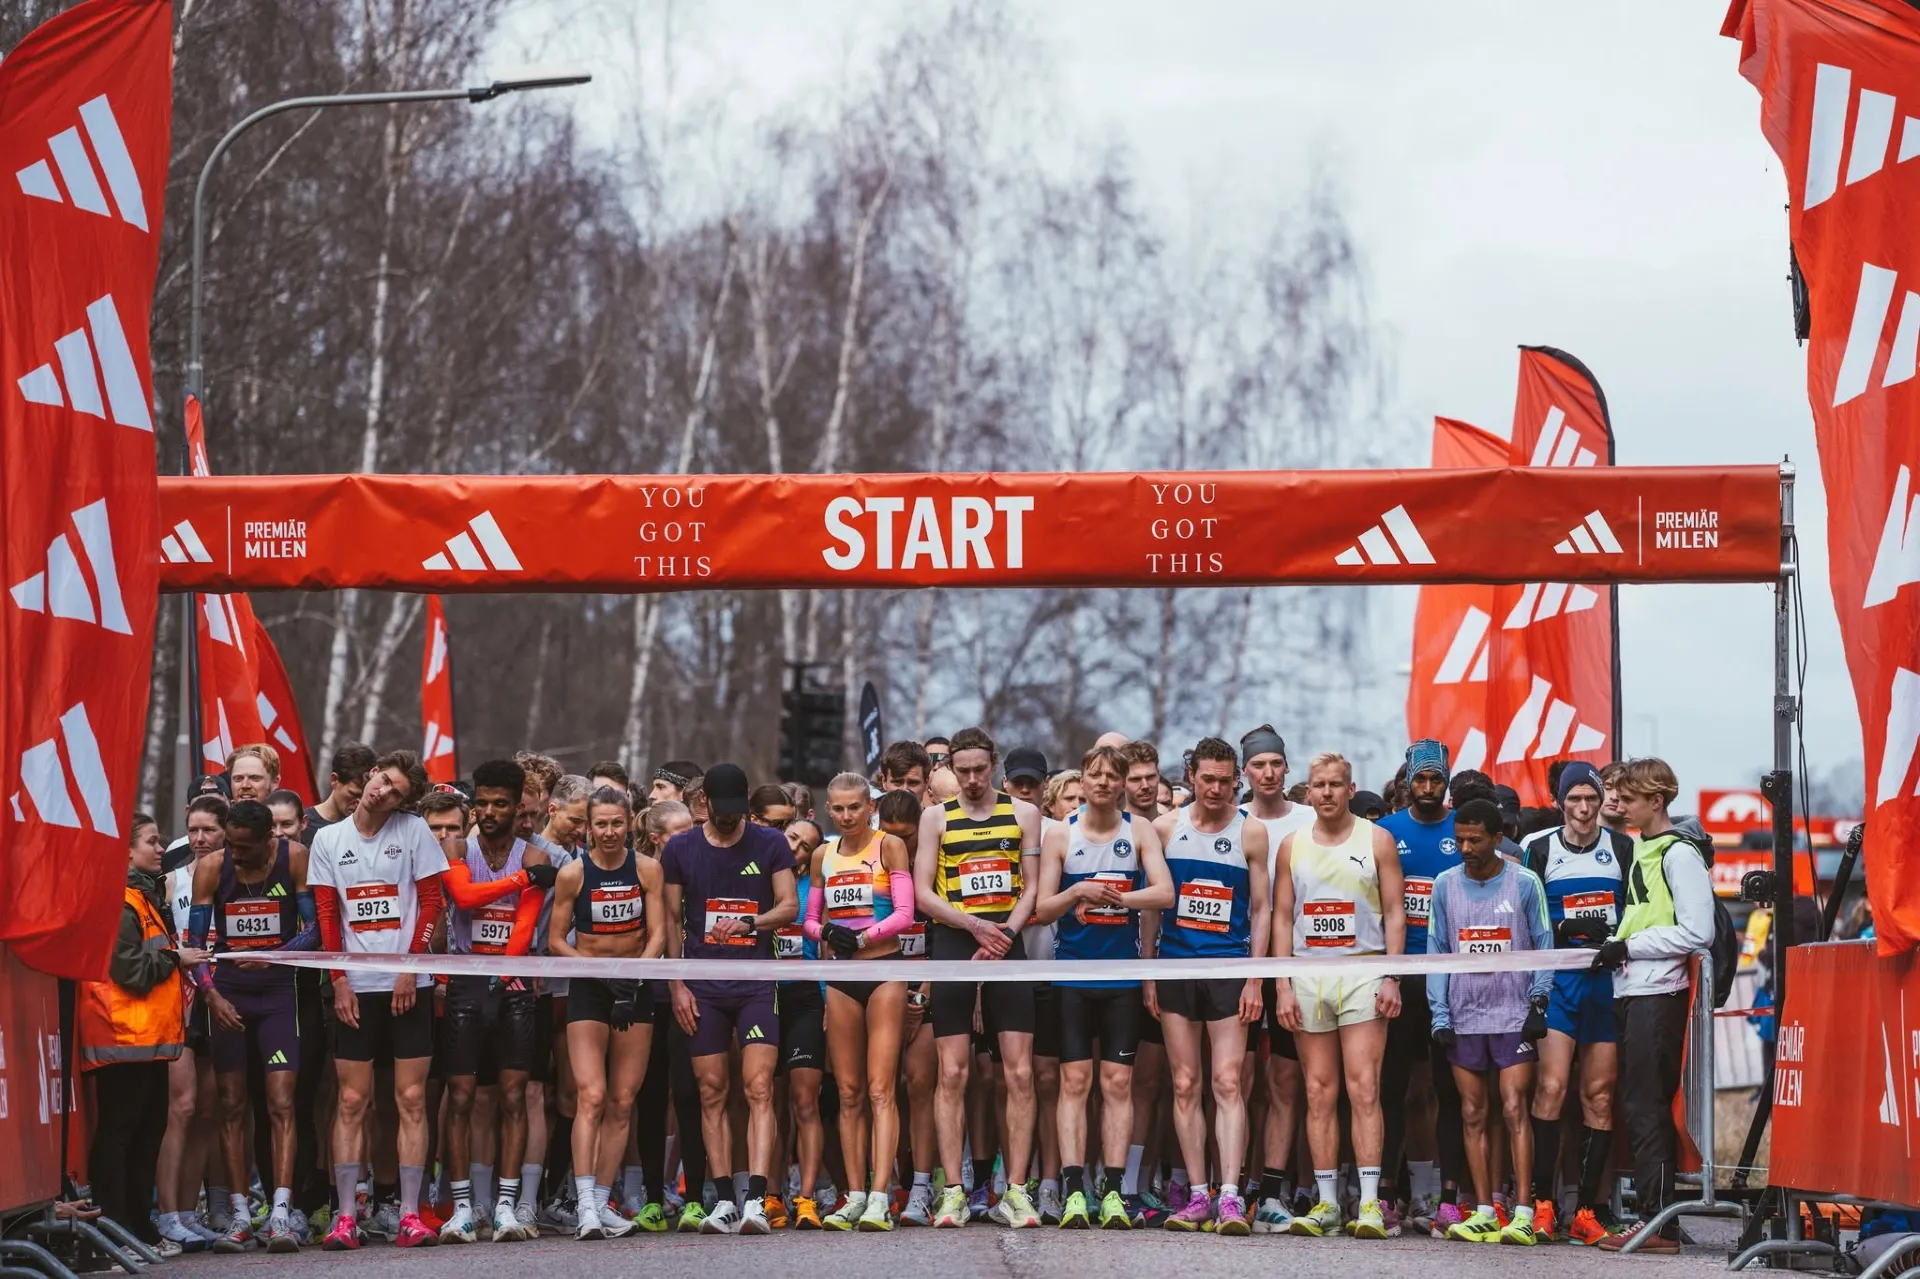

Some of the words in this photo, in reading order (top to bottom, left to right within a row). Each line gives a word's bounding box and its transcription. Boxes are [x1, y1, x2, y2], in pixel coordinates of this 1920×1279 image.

[639, 487, 706, 508] YOU
[1150, 483, 1217, 505] YOU
[244, 518, 307, 539] PREMIÄR
[1655, 508, 1719, 529] PREMIÄR
[639, 521, 706, 542] GOT
[821, 496, 1035, 571] START
[1151, 518, 1218, 540] GOT
[244, 540, 307, 559] MILEN
[1655, 531, 1719, 549] MILEN
[633, 555, 712, 577] THIS
[1145, 552, 1223, 573] THIS
[971, 874, 1004, 891] 6173
[833, 887, 863, 904] 6484
[357, 900, 390, 917] 5973
[602, 902, 634, 919] 6174
[1188, 900, 1221, 917] 5912
[236, 917, 271, 932] 6431
[421, 922, 435, 943] VOID
[481, 923, 511, 940] 5971
[1313, 917, 1346, 932] 5908
